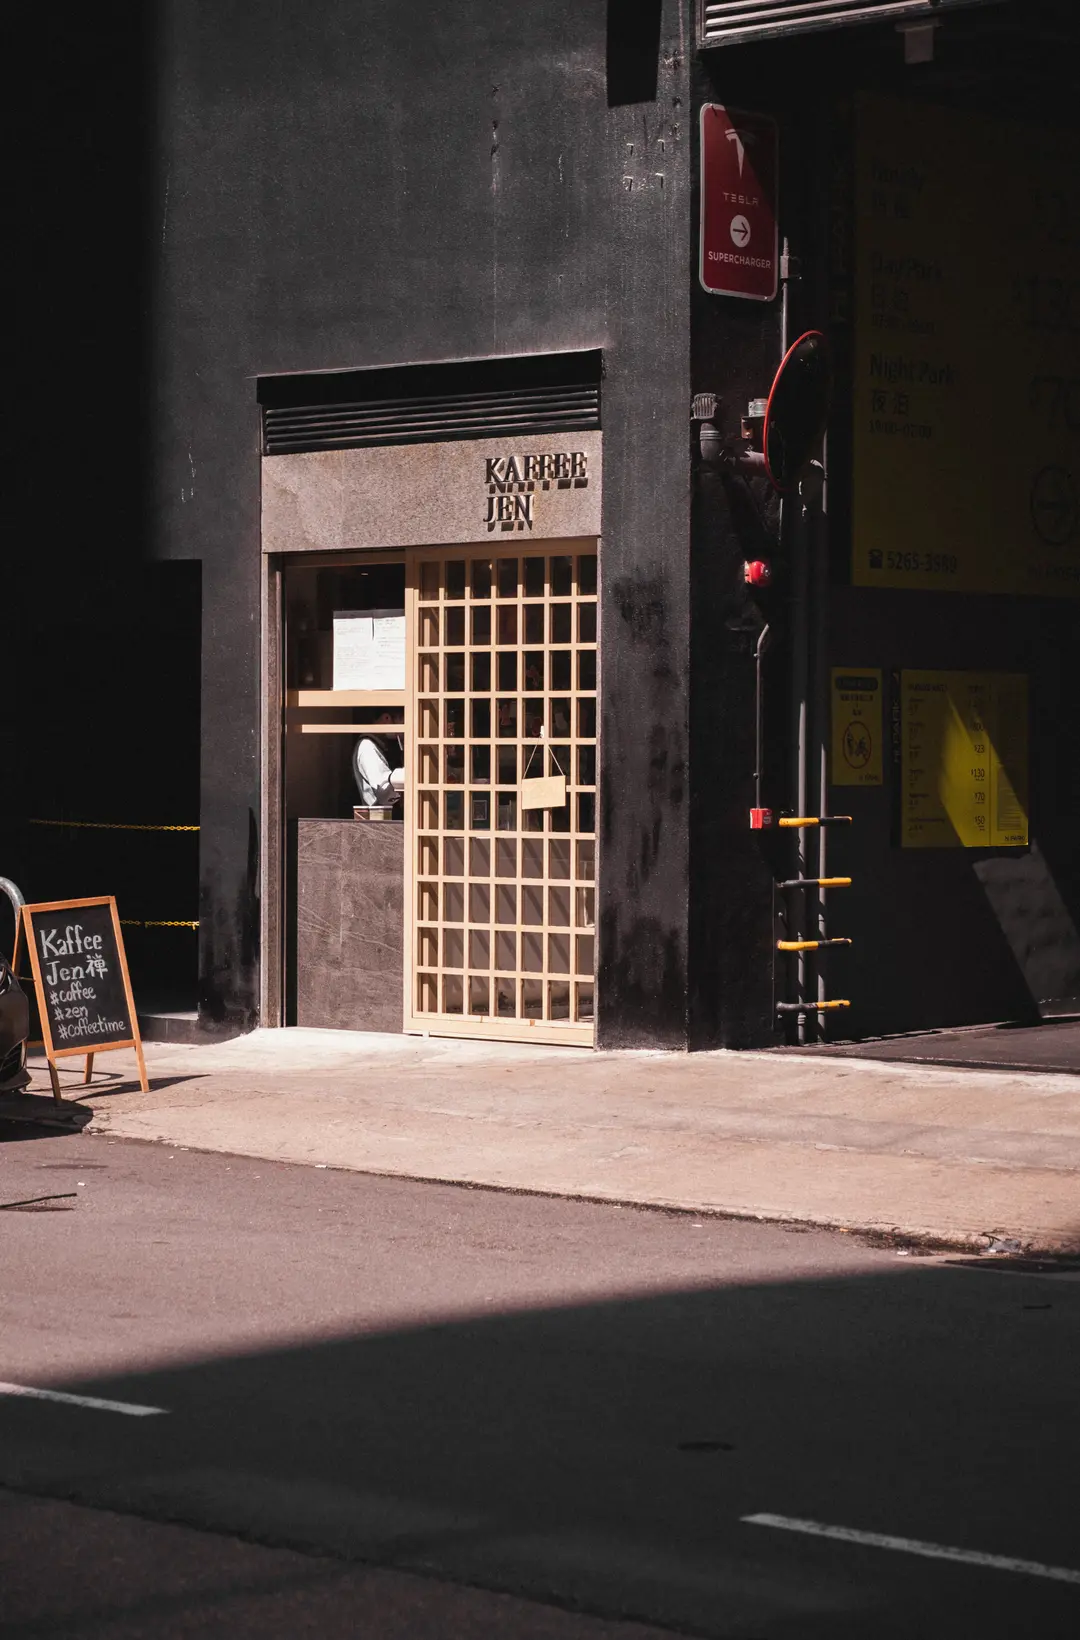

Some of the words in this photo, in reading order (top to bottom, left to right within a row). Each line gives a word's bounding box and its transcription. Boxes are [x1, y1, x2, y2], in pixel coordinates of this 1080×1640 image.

[722, 191, 760, 207] TESLA
[708, 250, 772, 270] SUPERCHARGER
[870, 351, 915, 384] Night
[918, 359, 954, 386] Park
[484, 451, 588, 484] KAFFEE
[483, 494, 534, 523] JEN
[39, 924, 103, 959] Kaffee
[49, 981, 97, 1006] #coffee
[53, 1006, 89, 1021] #zen
[57, 1015, 127, 1040] #coffeetime
